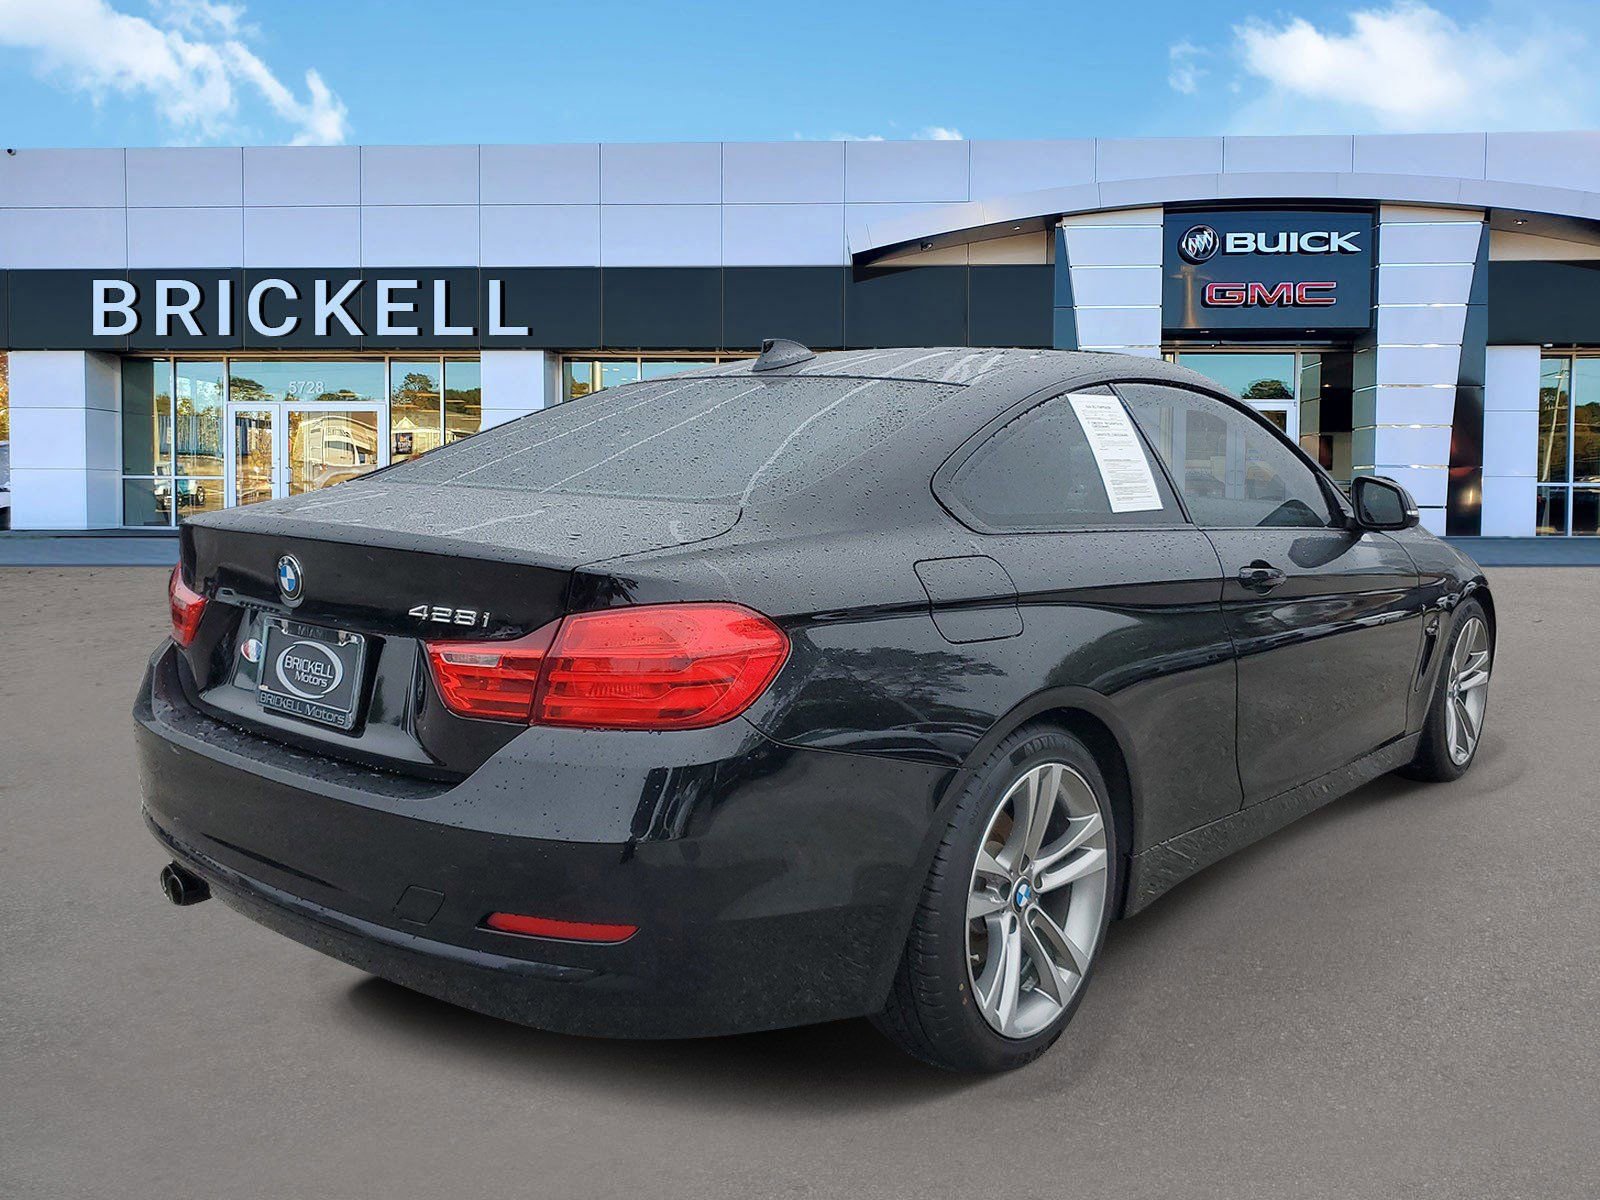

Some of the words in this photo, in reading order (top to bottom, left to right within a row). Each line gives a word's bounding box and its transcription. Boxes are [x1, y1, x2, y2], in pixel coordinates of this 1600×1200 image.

[1225, 231, 1361, 254] BUICK
[1204, 281, 1337, 306] GMC
[92, 278, 531, 338] BRICKELL
[289, 380, 324, 396] 5728
[408, 604, 490, 628] 428i
[284, 655, 334, 679] BRICKELL
[294, 670, 328, 688] Motors
[259, 692, 303, 714] BRICKELL
[305, 704, 346, 725] Motors
